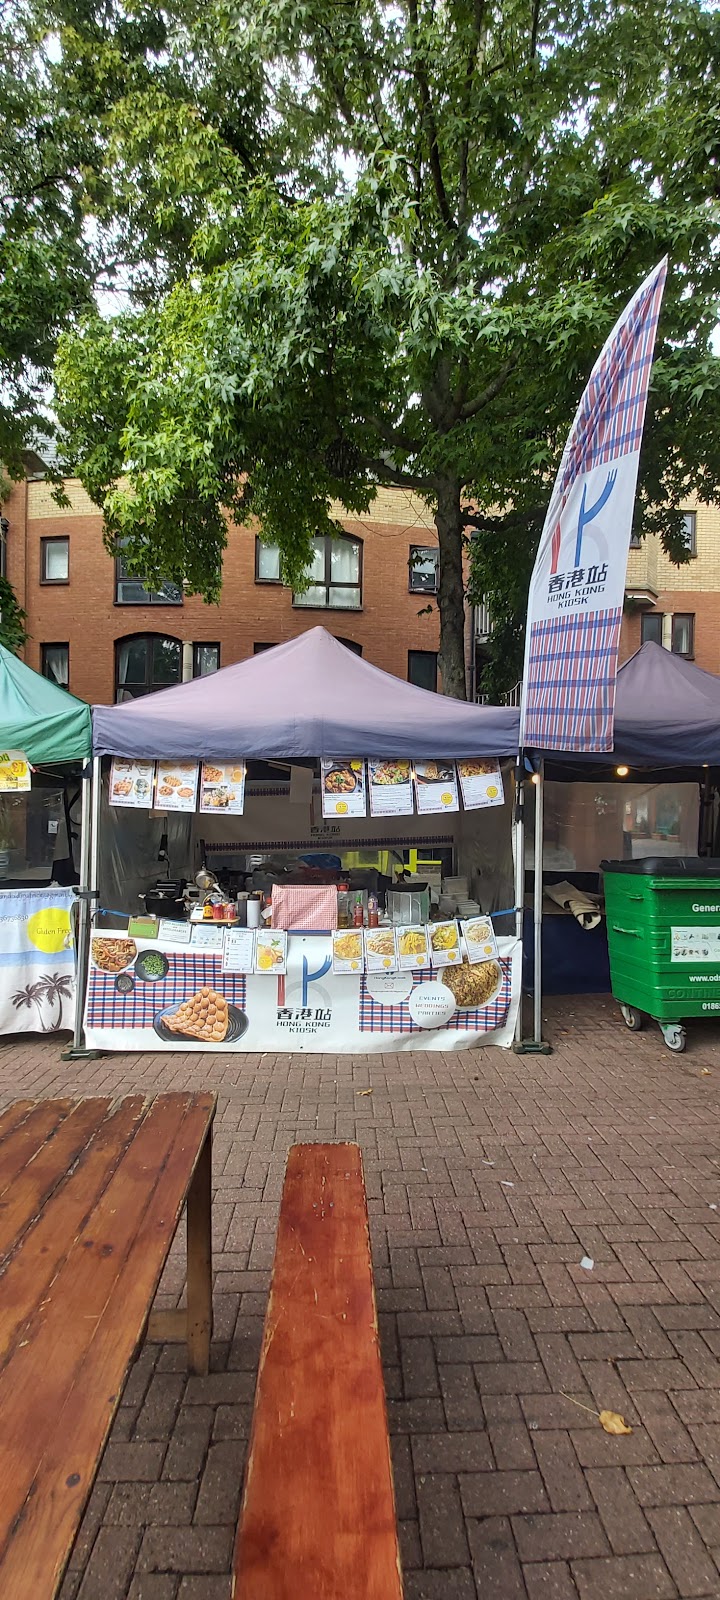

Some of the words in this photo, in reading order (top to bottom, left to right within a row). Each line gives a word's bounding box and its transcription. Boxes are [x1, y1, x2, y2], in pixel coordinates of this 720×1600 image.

[548, 563, 608, 593] 香港站
[547, 591, 571, 603] HONG
[574, 584, 606, 597] KONG
[558, 596, 589, 609] KIOSK
[692, 903, 720, 912] Gener
[277, 1007, 332, 1020] 香港站
